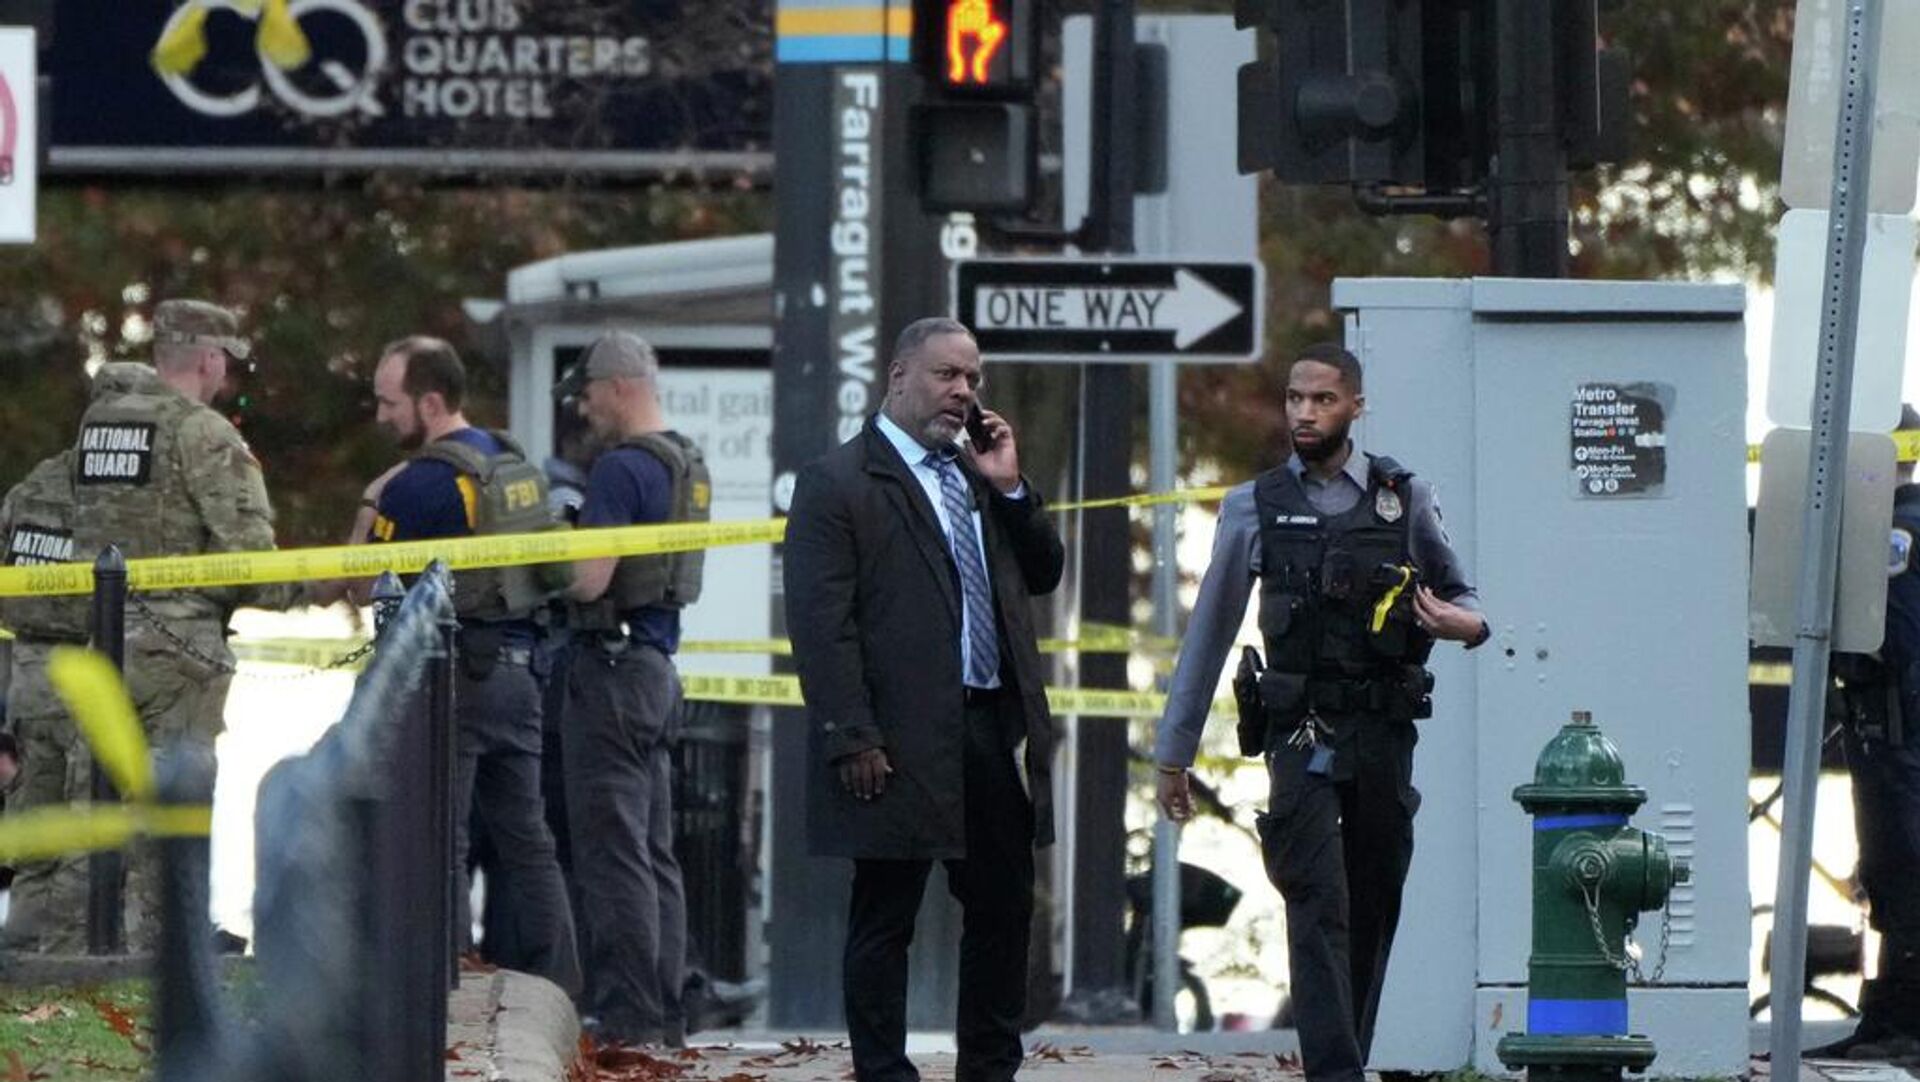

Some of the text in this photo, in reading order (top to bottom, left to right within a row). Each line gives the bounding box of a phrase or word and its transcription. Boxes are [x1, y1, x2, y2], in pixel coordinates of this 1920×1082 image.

[403, 0, 520, 32] CLUB
[403, 36, 649, 75] QUARTERS
[403, 78, 554, 117] HOTEL
[831, 73, 878, 446] Farragut Wes
[987, 290, 1164, 328] ONE WAY
[1574, 402, 1637, 417] Transfer
[84, 452, 140, 476] GUARD
[504, 480, 540, 511] FBI
[11, 530, 74, 561] NATIONA
